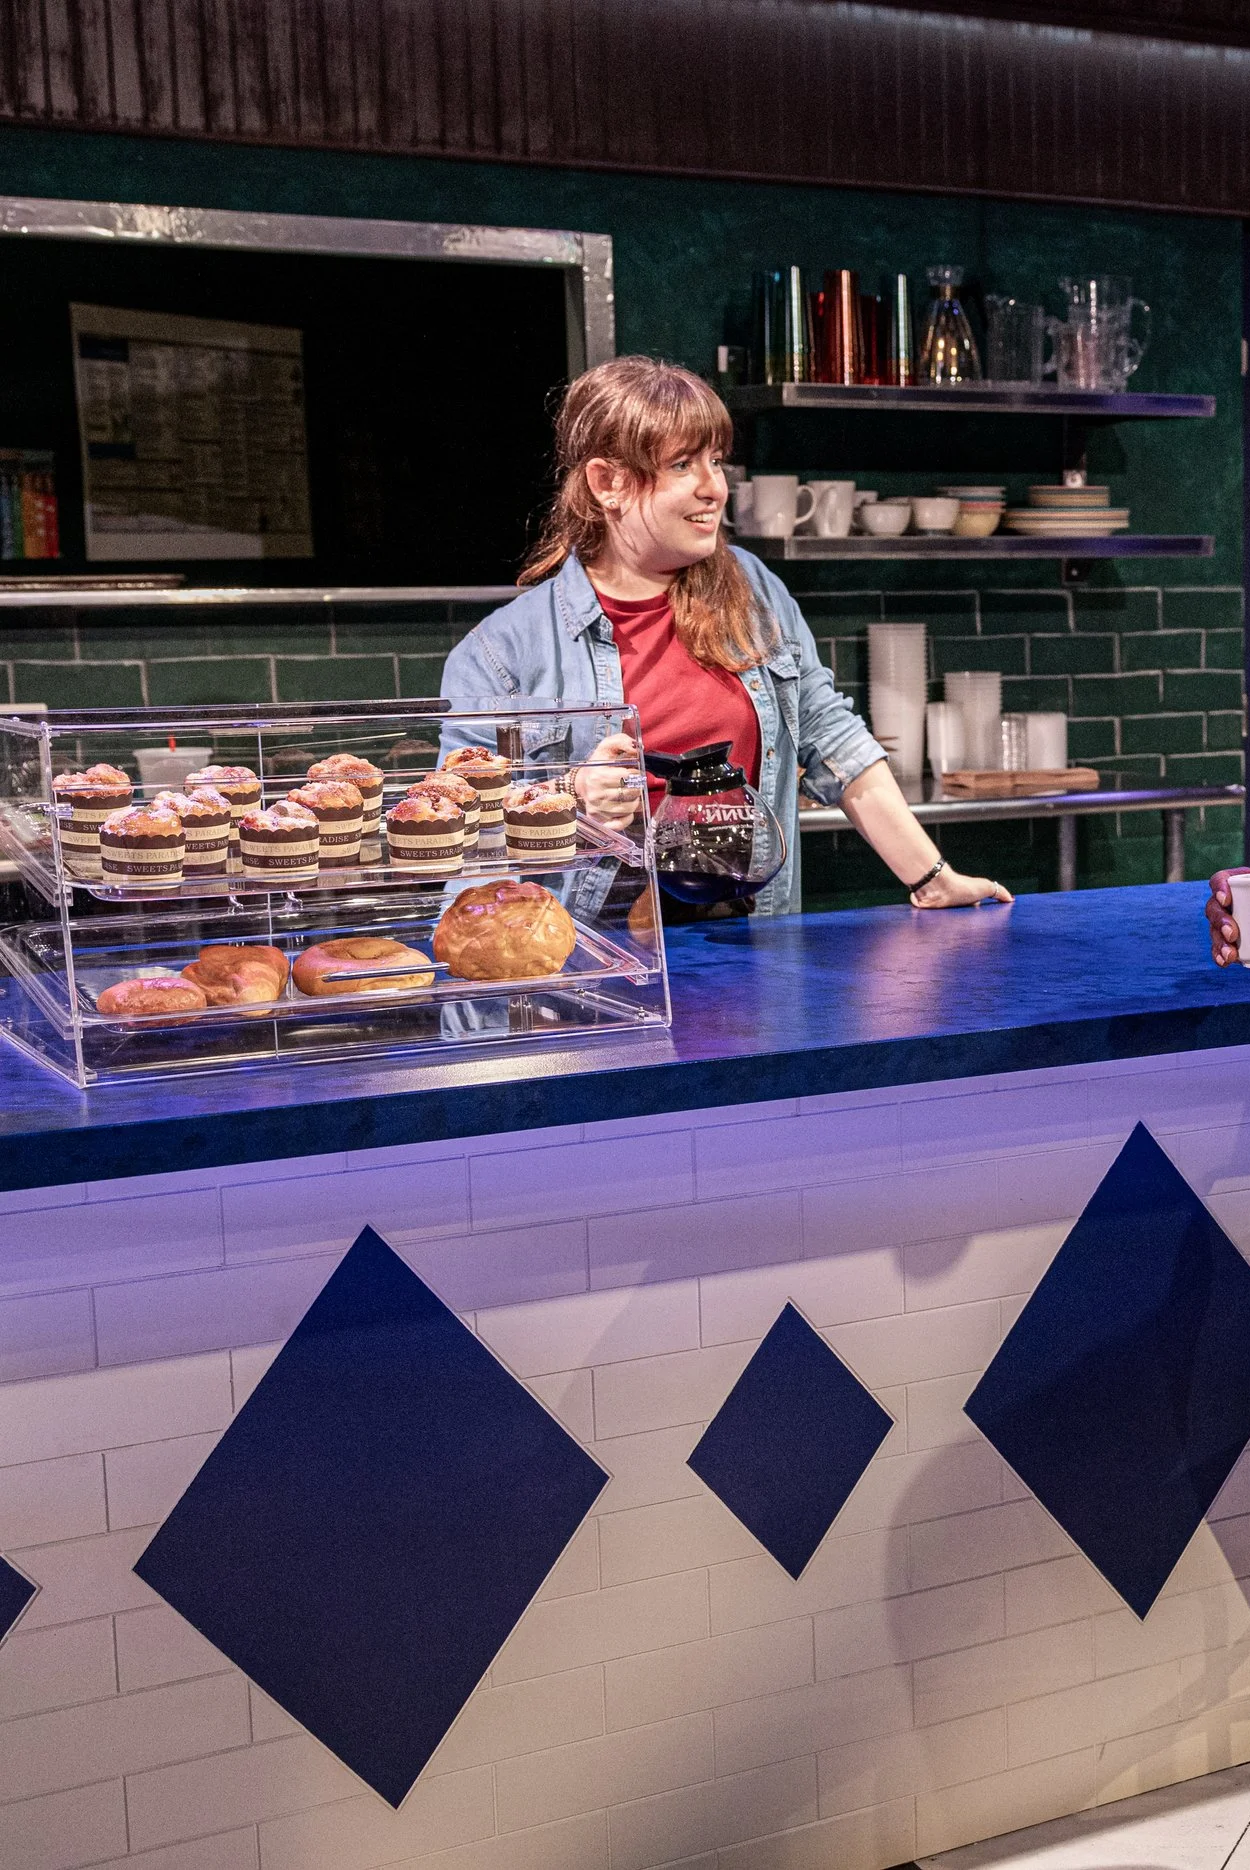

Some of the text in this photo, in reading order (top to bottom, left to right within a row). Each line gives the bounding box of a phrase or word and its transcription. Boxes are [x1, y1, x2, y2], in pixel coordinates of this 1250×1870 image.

[517, 840, 554, 848] SWEETS
[400, 849, 438, 858] SWEETS
[268, 856, 307, 866] SWEETS
[126, 863, 169, 873] SWEETS
